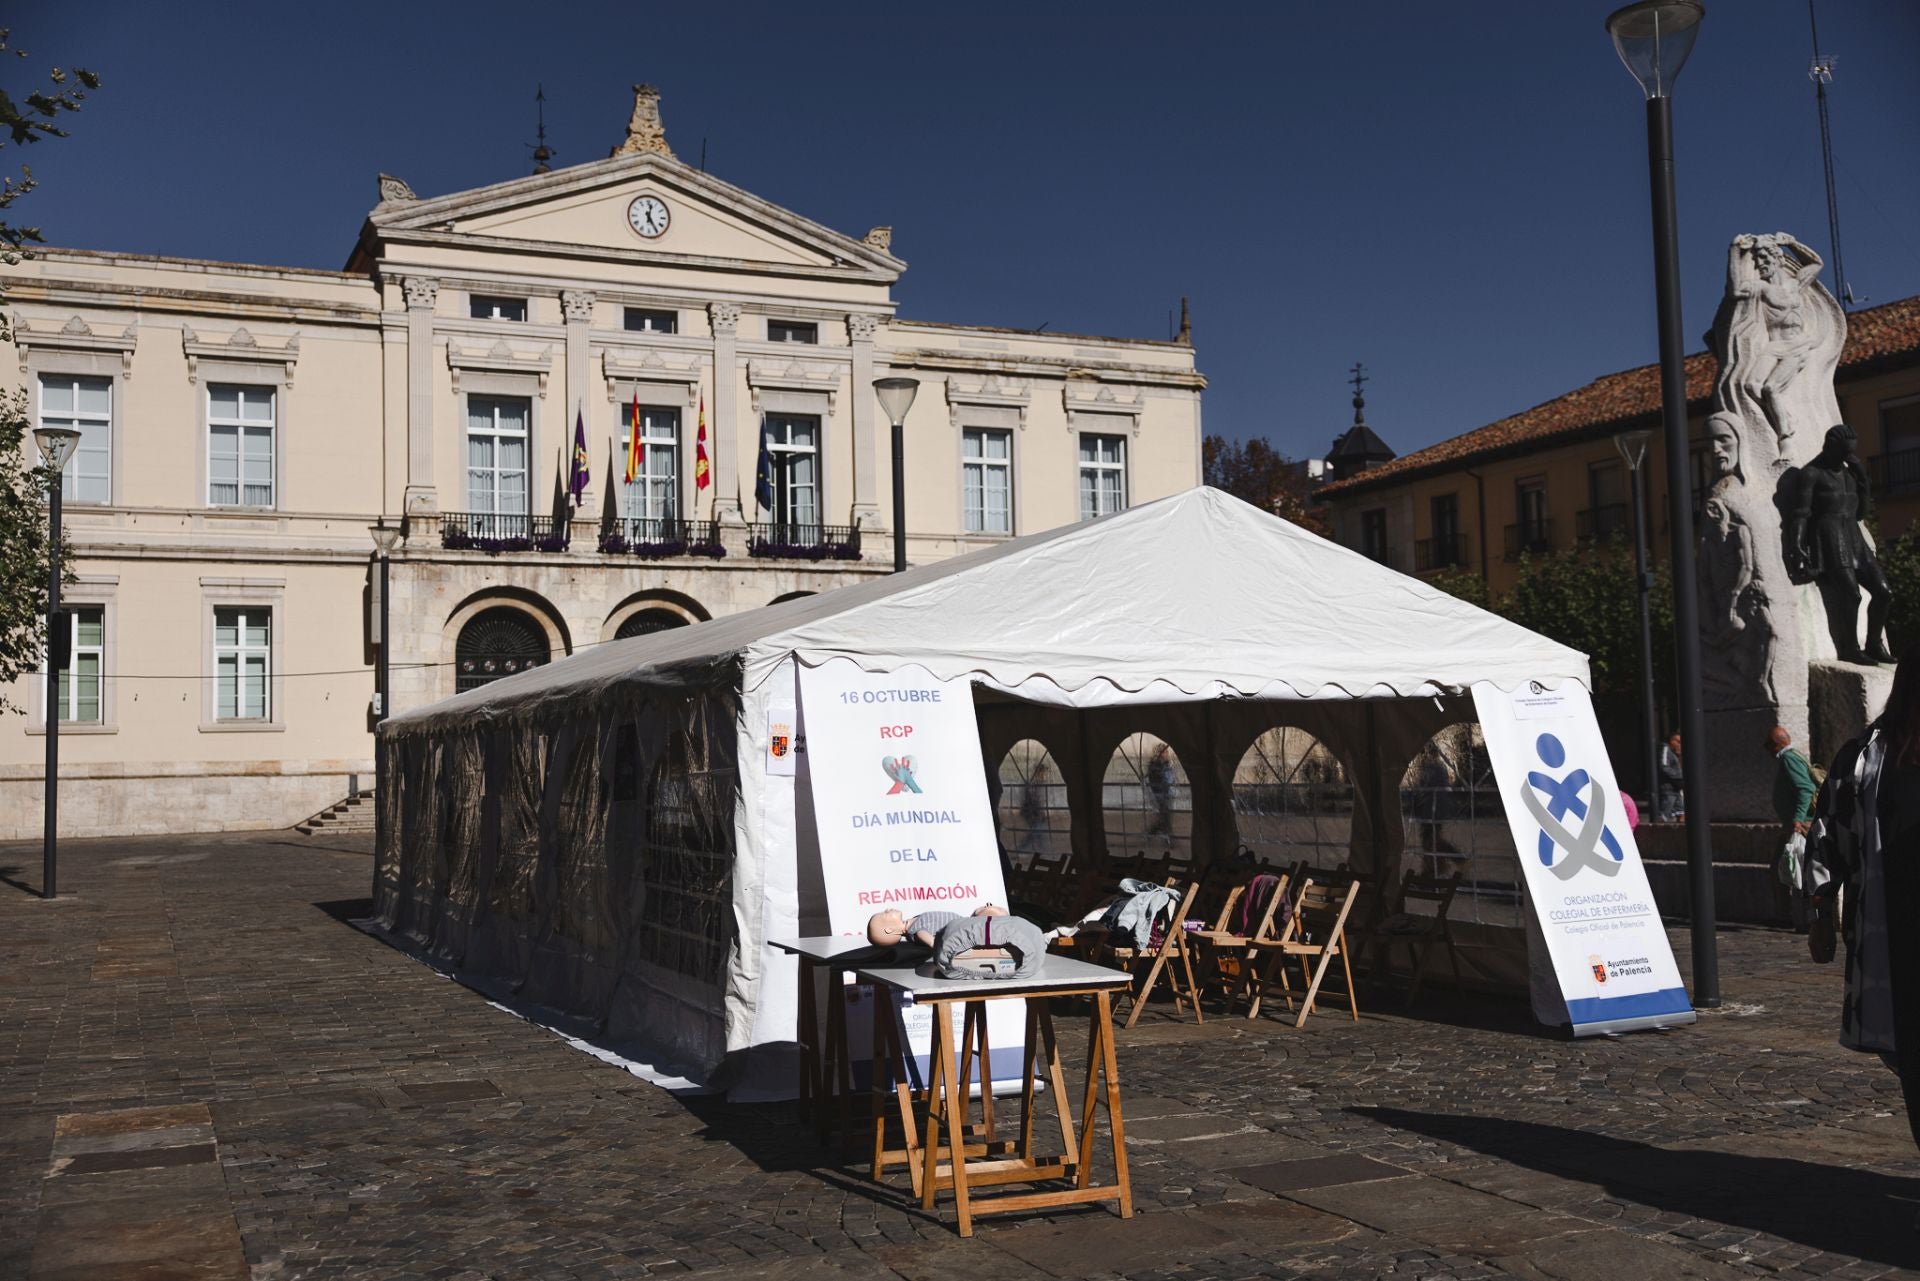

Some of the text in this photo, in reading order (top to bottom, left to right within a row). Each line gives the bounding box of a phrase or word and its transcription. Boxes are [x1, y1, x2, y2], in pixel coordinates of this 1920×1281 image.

[840, 690, 942, 704] 16 OCTUBRE
[880, 725, 913, 739] RCP
[852, 810, 961, 829] DÍA MUNDIAL
[890, 848, 938, 863] DE LA
[858, 883, 978, 905] REANIMACIÓN
[1563, 891, 1628, 906] ORGANIZACIÓN
[1549, 902, 1650, 921] COLEGIAL DE ENFERMERÍA
[1607, 957, 1649, 969] Ayuntamiento
[1610, 965, 1652, 978] de Palencia
